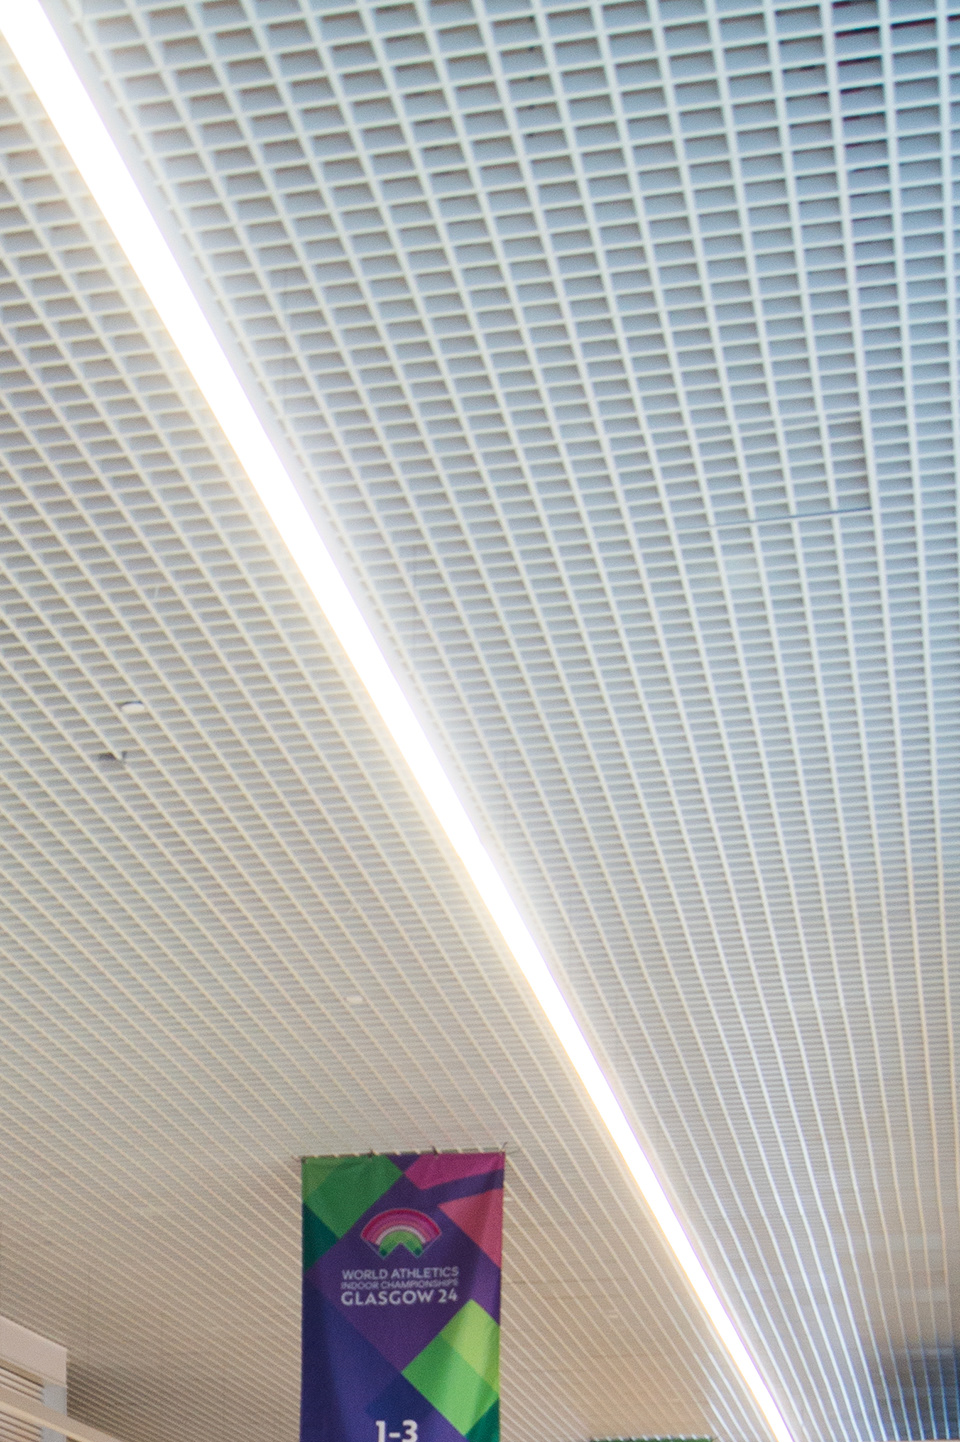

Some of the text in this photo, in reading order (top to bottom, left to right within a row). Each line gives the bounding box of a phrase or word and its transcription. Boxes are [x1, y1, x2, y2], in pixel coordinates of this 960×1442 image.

[341, 1266, 459, 1281] WORLD ATHLETICS
[341, 1279, 458, 1290] INDOOR CHAMPIONSHIPS
[340, 1287, 458, 1306] GLASGOW 24
